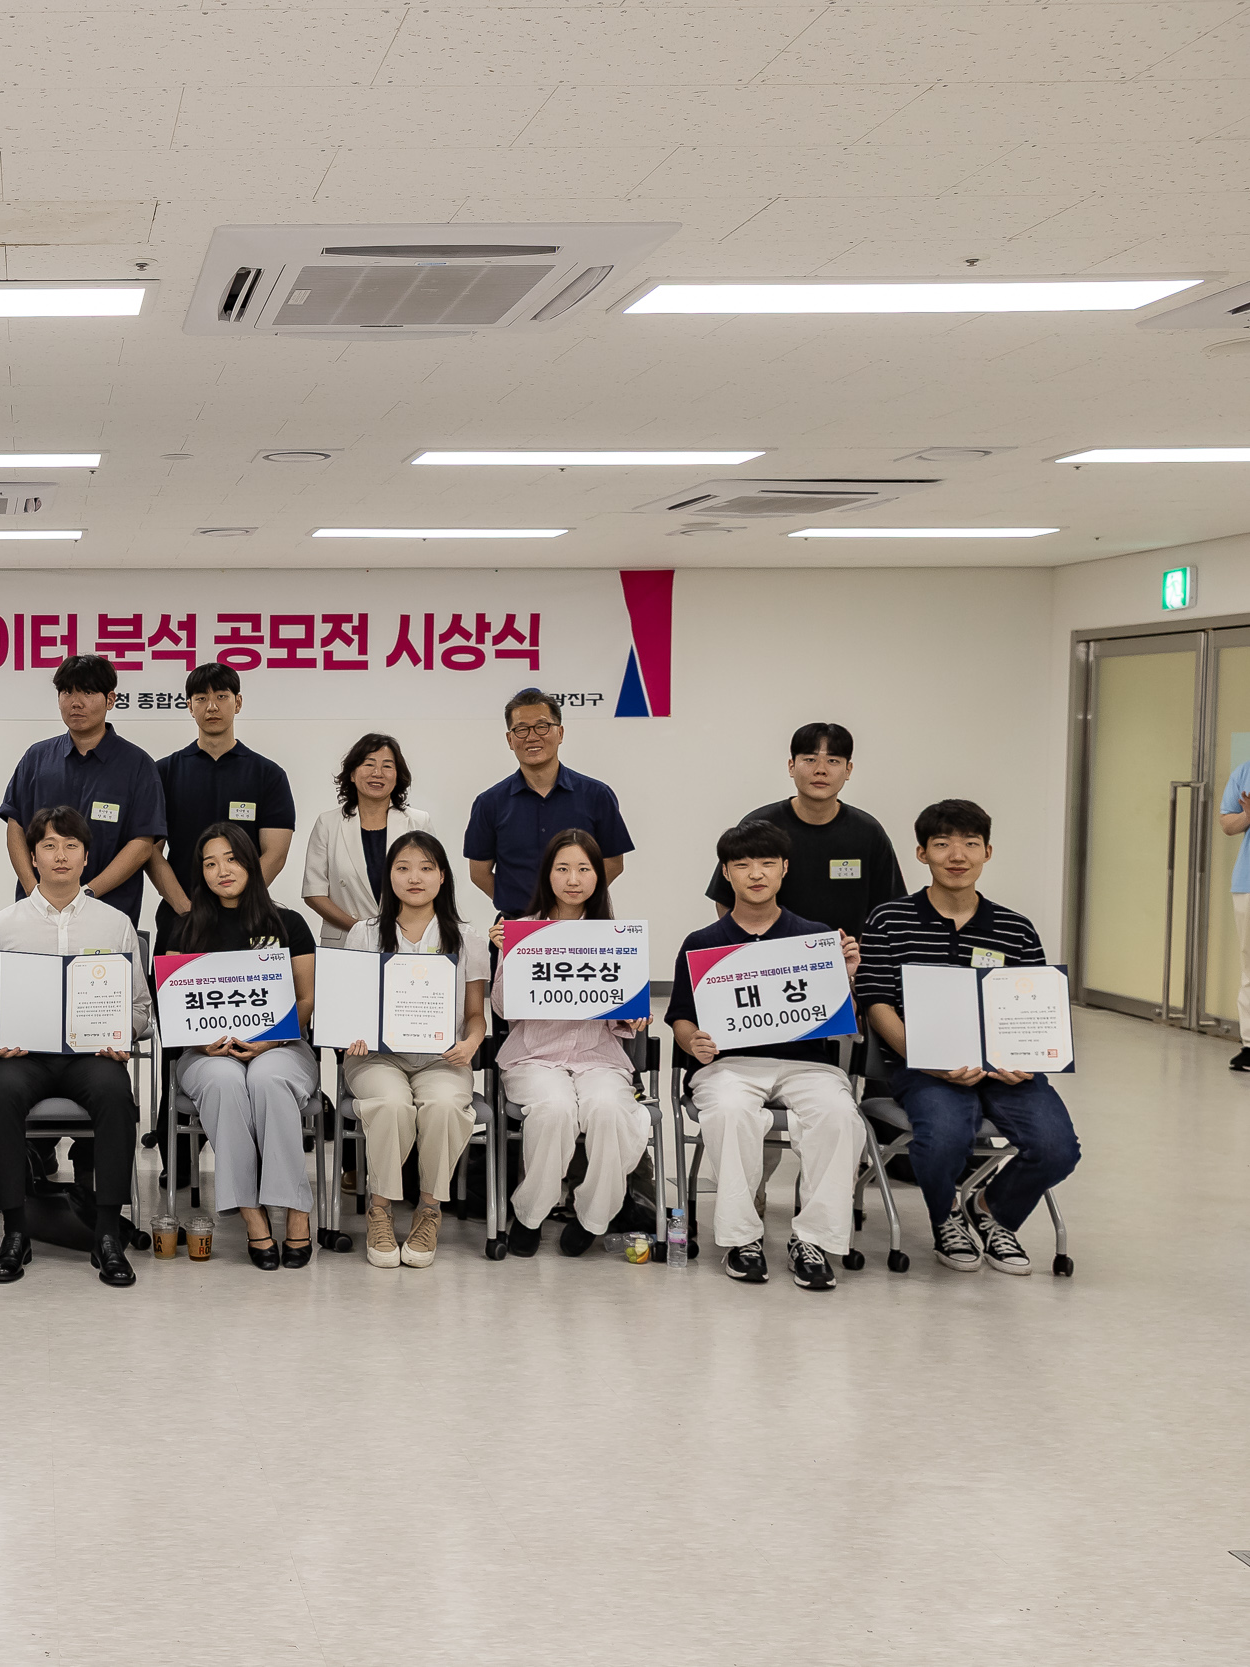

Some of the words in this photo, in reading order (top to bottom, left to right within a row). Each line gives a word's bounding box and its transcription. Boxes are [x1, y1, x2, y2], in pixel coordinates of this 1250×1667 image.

[95, 613, 196, 671] 분석
[214, 613, 368, 671] 공모전
[386, 613, 540, 671] 시상식
[196, 977, 216, 985] 광진구
[218, 975, 245, 984] 빅데이터
[261, 973, 282, 981] 공모전
[532, 962, 621, 982] 최우수상
[705, 972, 733, 984] 2025년
[735, 971, 758, 980] 광진구
[760, 967, 790, 977] 빅데이터
[809, 961, 834, 971] 공모전
[185, 988, 268, 1010] 최우수상
[529, 989, 624, 1005] 1,000,000원
[185, 1012, 275, 1032] 1,000,000원
[726, 1004, 828, 1032] 3,000,000원
